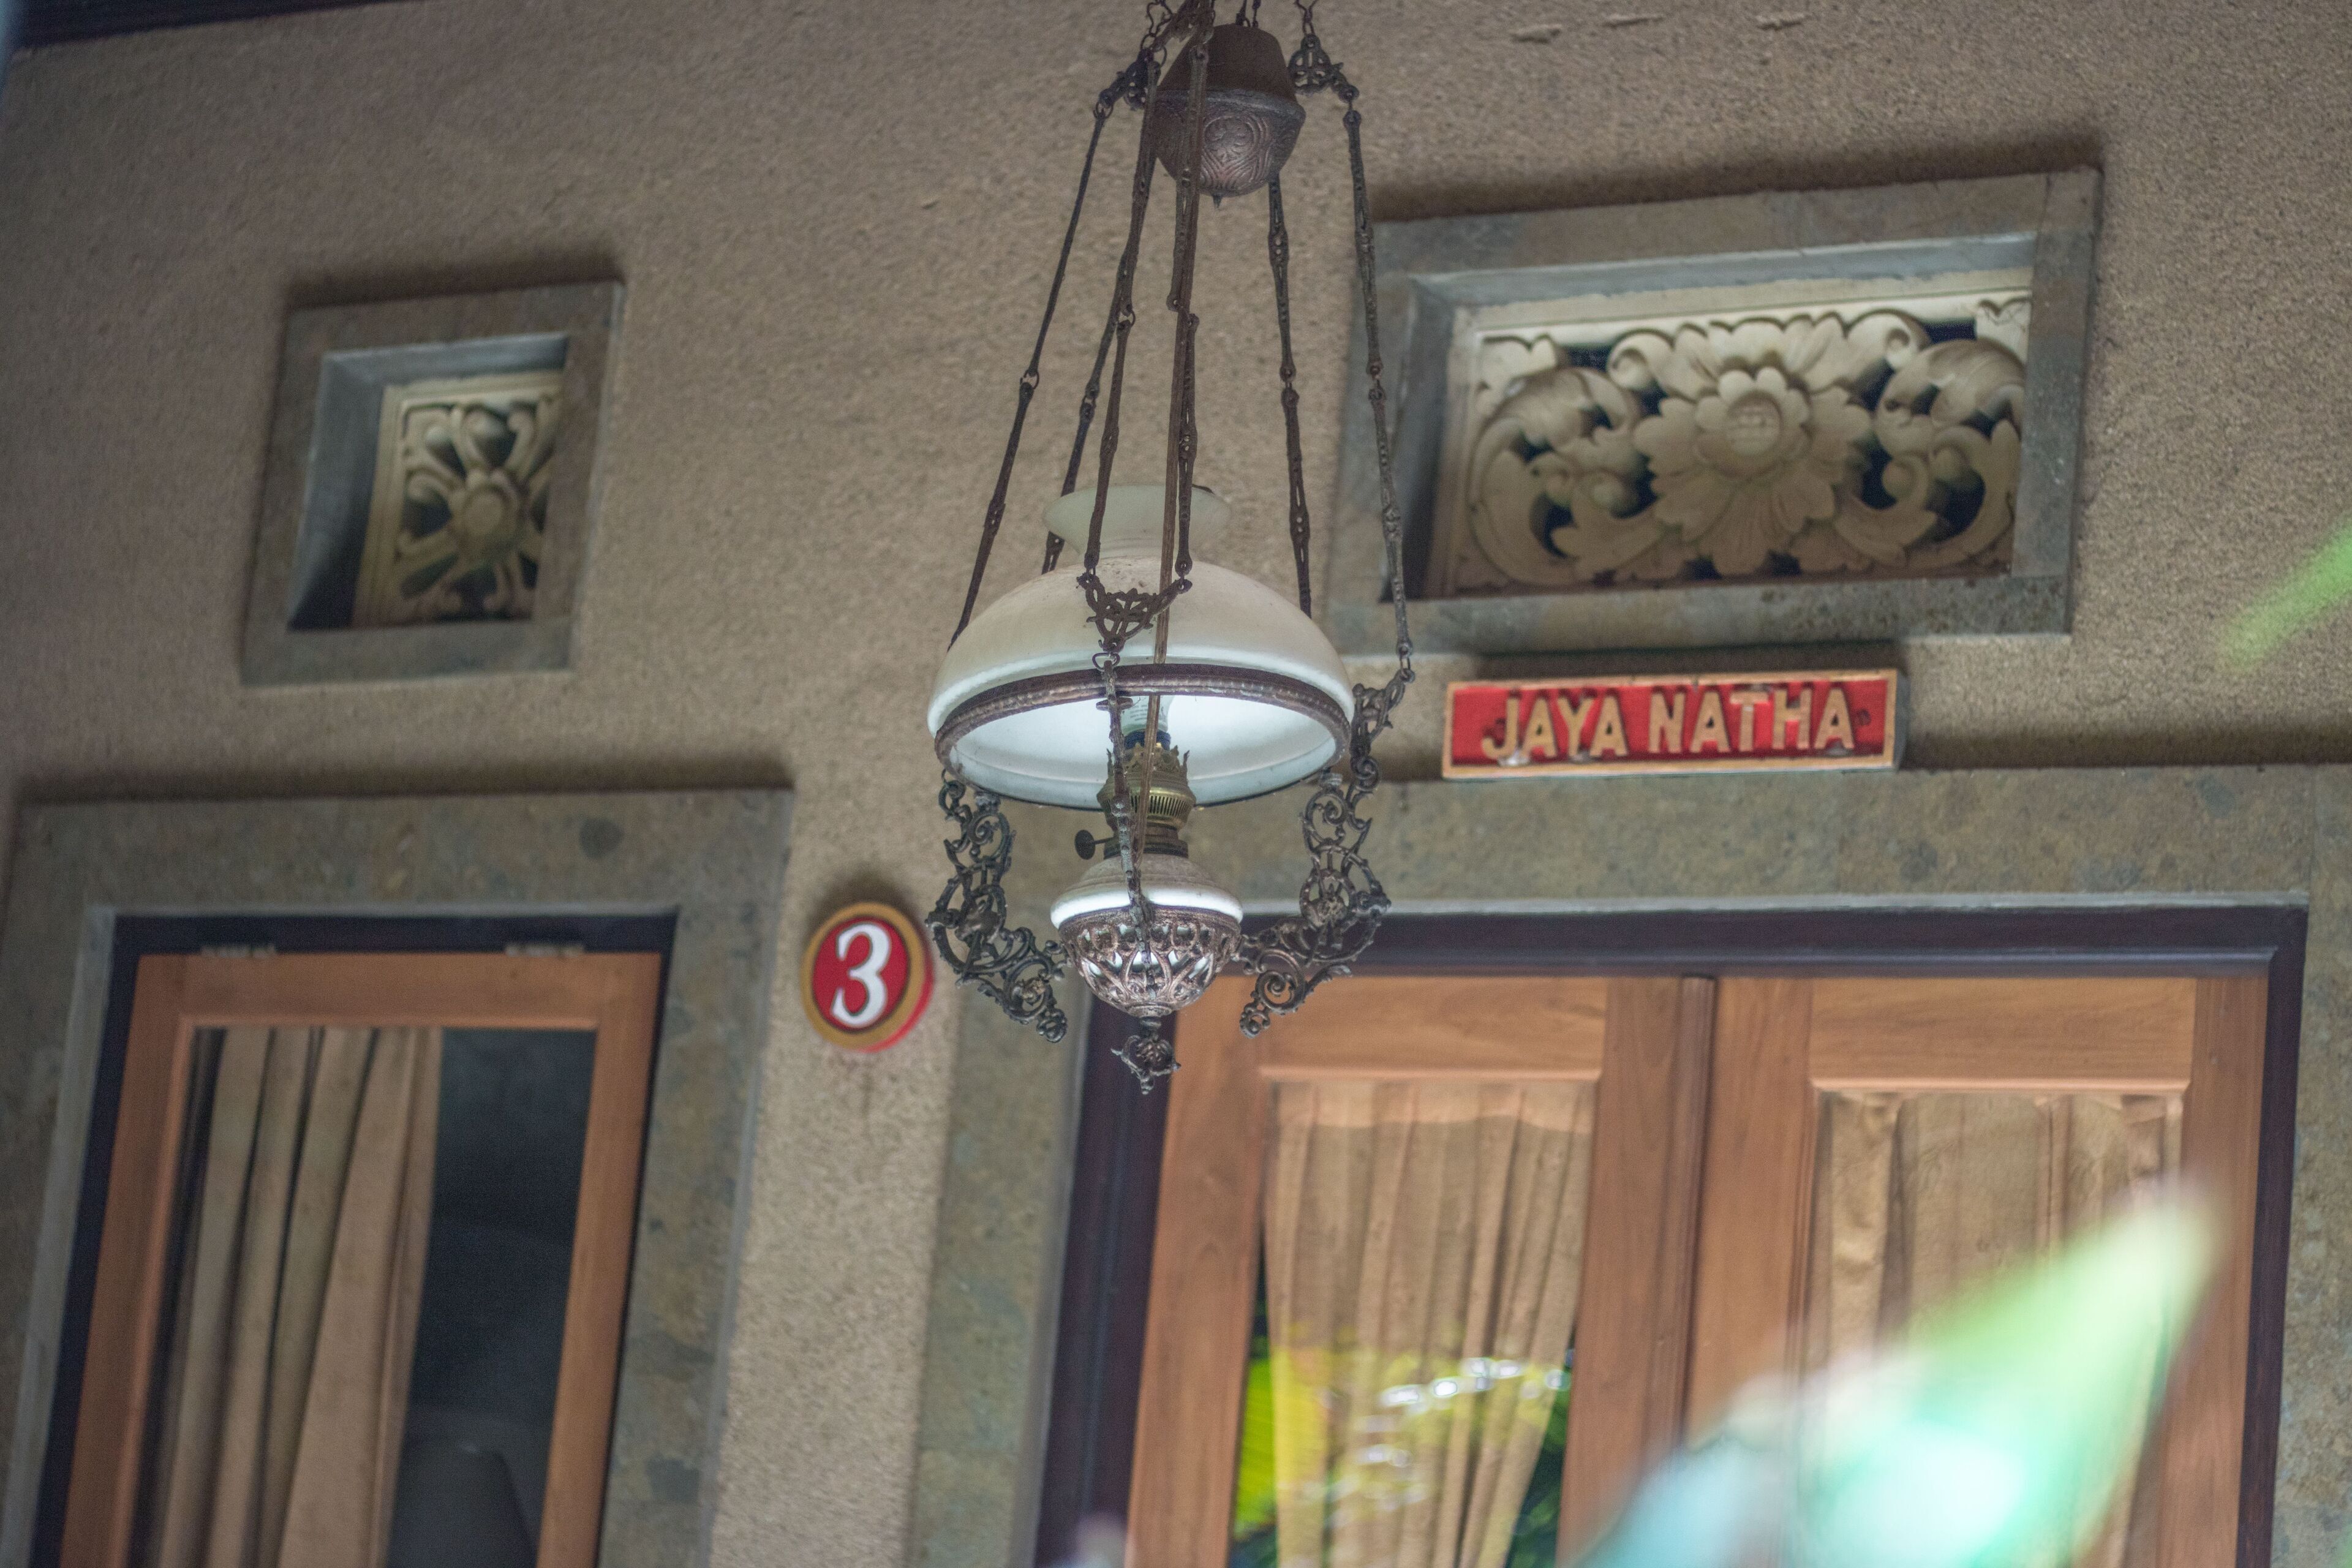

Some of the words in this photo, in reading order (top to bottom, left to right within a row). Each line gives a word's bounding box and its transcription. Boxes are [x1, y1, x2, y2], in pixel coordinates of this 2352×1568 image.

[1482, 696, 1627, 759] JAYA
[1649, 689, 1854, 752] NATHA
[832, 923, 890, 1027] 3
